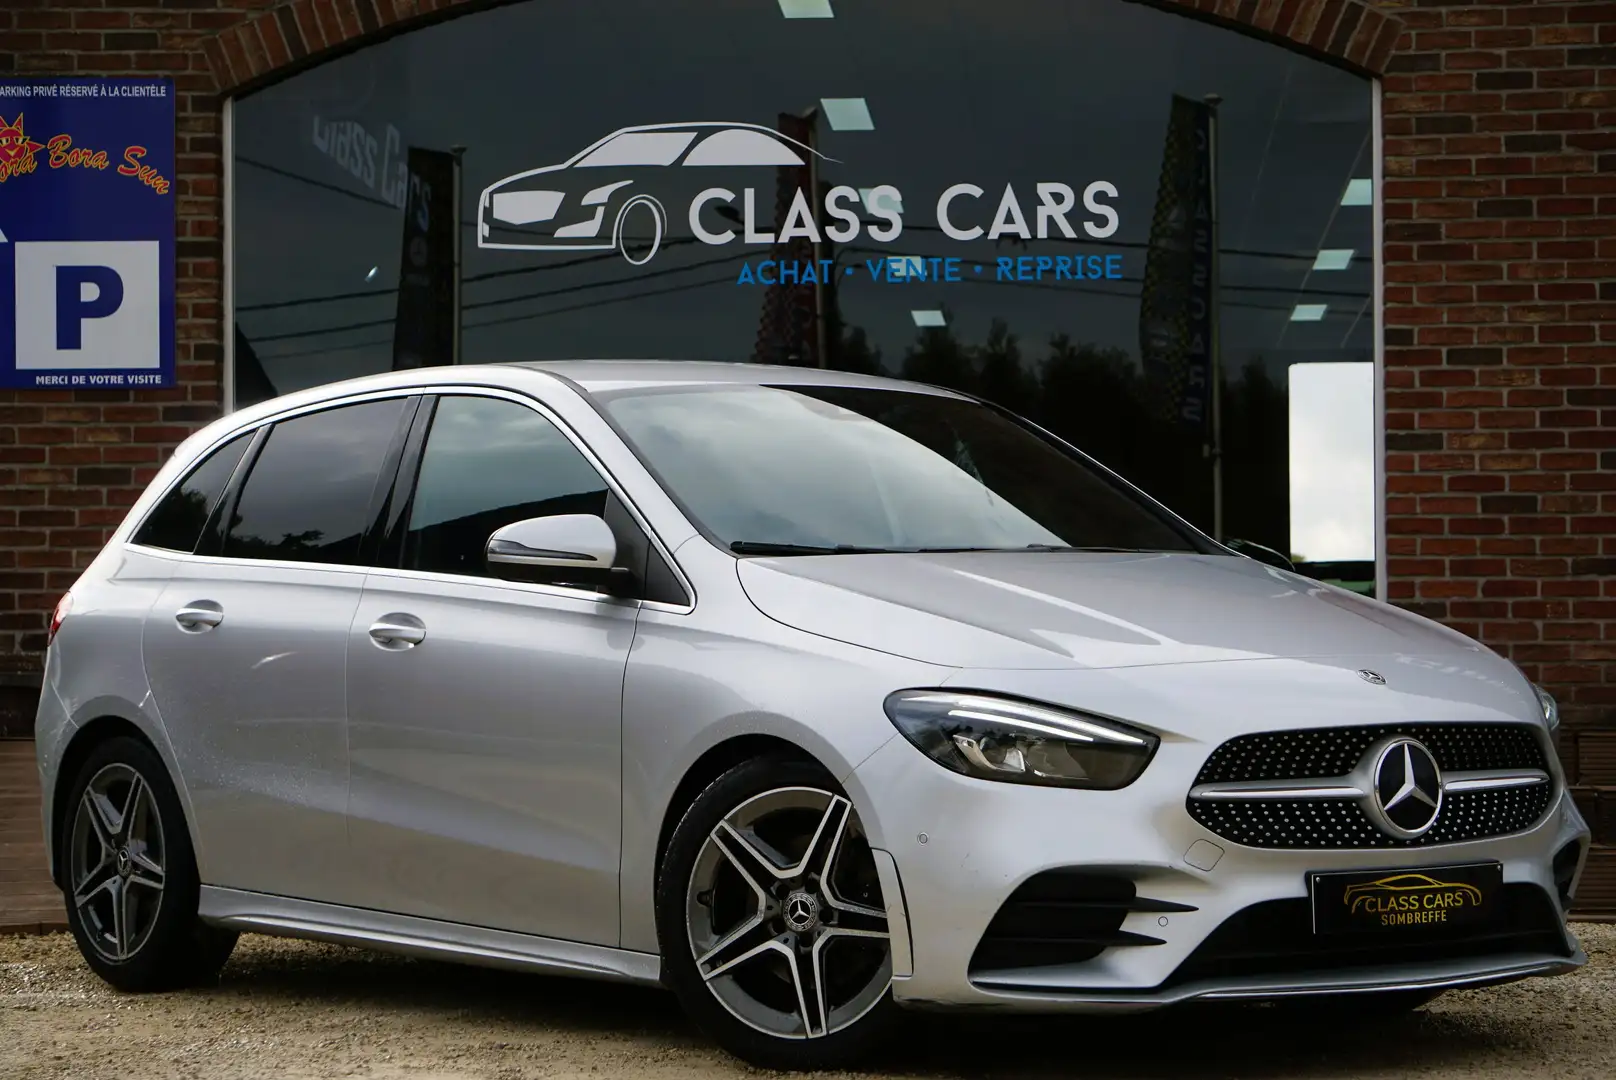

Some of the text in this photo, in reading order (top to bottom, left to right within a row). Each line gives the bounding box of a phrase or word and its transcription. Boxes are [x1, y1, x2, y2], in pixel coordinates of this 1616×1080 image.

[0, 85, 31, 97] ARKING
[33, 83, 58, 97] PRIVÉ
[59, 83, 98, 97] RÉSERVÉ
[108, 86, 120, 97] LA
[0, 134, 170, 194] ora Bora Sun
[688, 181, 1120, 245] CLASS CARS
[737, 254, 1124, 285] ACHAT VENTE REPRISE
[55, 265, 124, 350] P
[35, 374, 162, 385] MERCI DE VOTRE VISITE
[1365, 892, 1463, 913] CLASS CARS
[1381, 910, 1447, 926] SOMBREFFE
